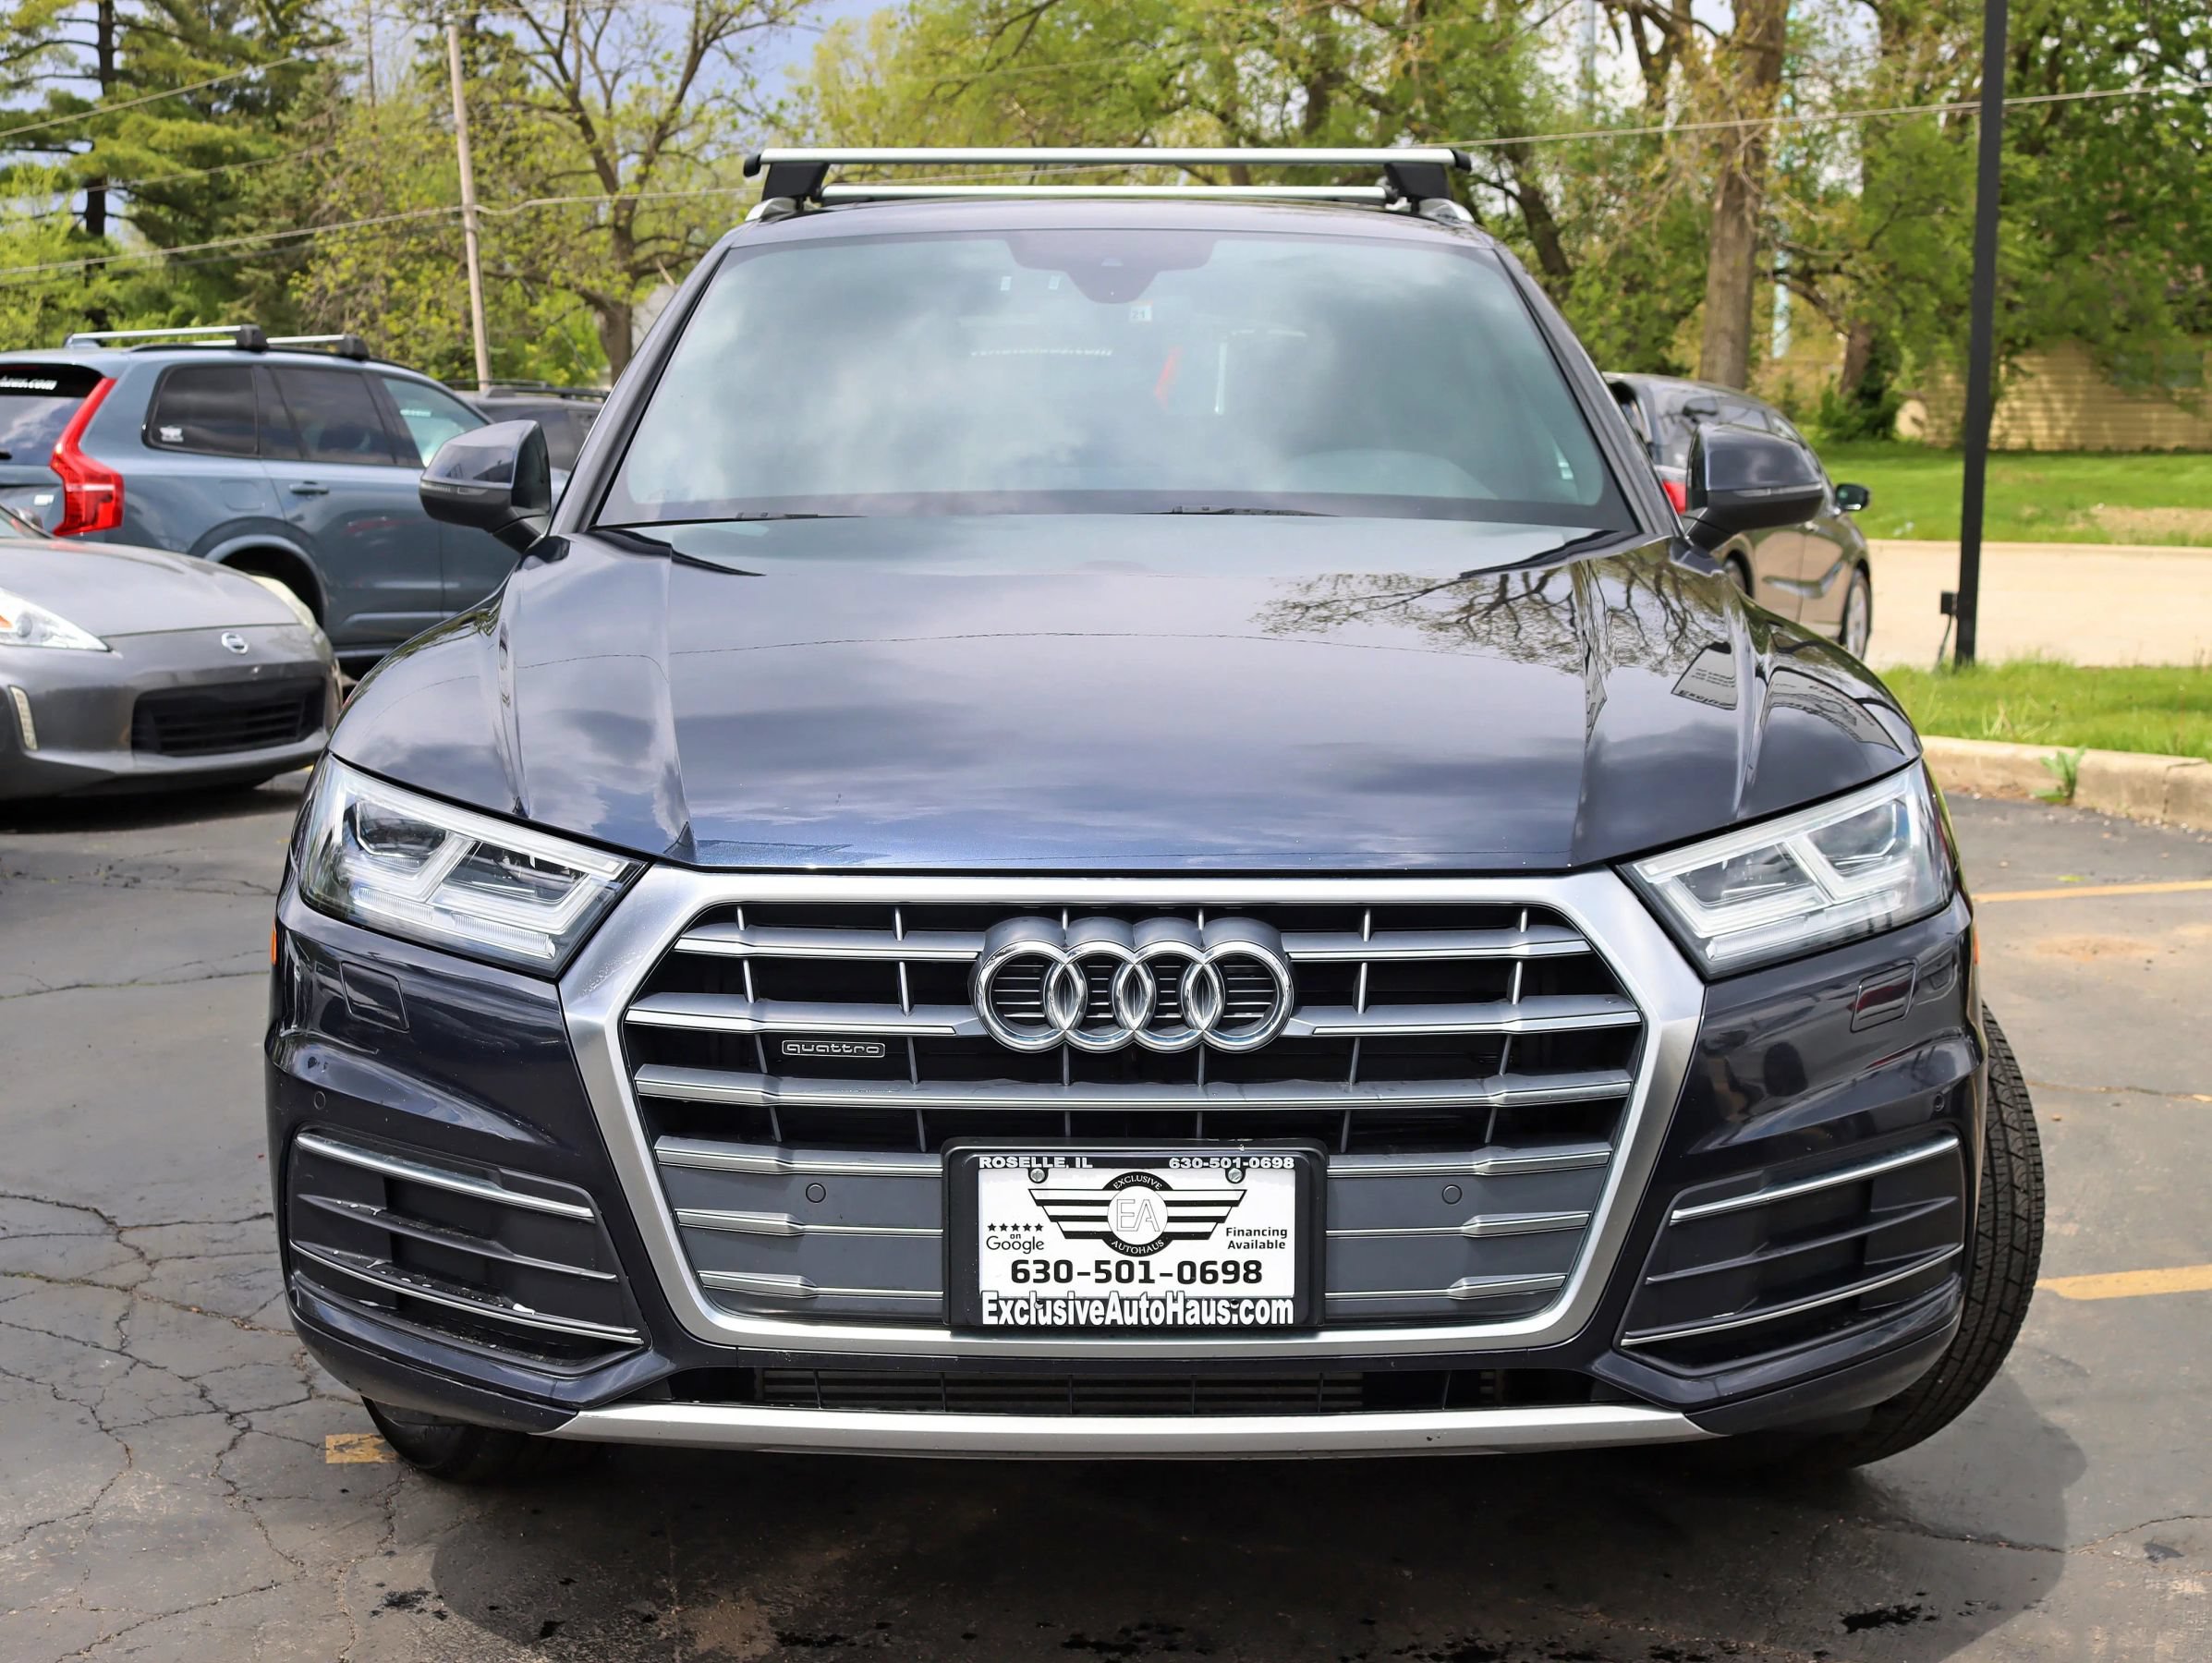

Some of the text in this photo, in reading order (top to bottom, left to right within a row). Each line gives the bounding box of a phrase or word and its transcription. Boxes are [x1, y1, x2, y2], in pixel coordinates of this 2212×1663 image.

[786, 1043, 881, 1054] quattro
[978, 1157, 1093, 1169] ROSELLE, IL
[1169, 1157, 1295, 1170] 630-501-0698
[1112, 1174, 1163, 1191] EXCLUSIVE
[1116, 1198, 1161, 1232] EA
[1225, 1227, 1288, 1239] Financing
[986, 1235, 1045, 1255] Google
[1111, 1239, 1165, 1255] AUTOHAUS
[1227, 1239, 1286, 1250] Available
[1010, 1259, 1263, 1284] 630-501-0698
[980, 1290, 1294, 1326] ExclusiveAutoHaus.com
